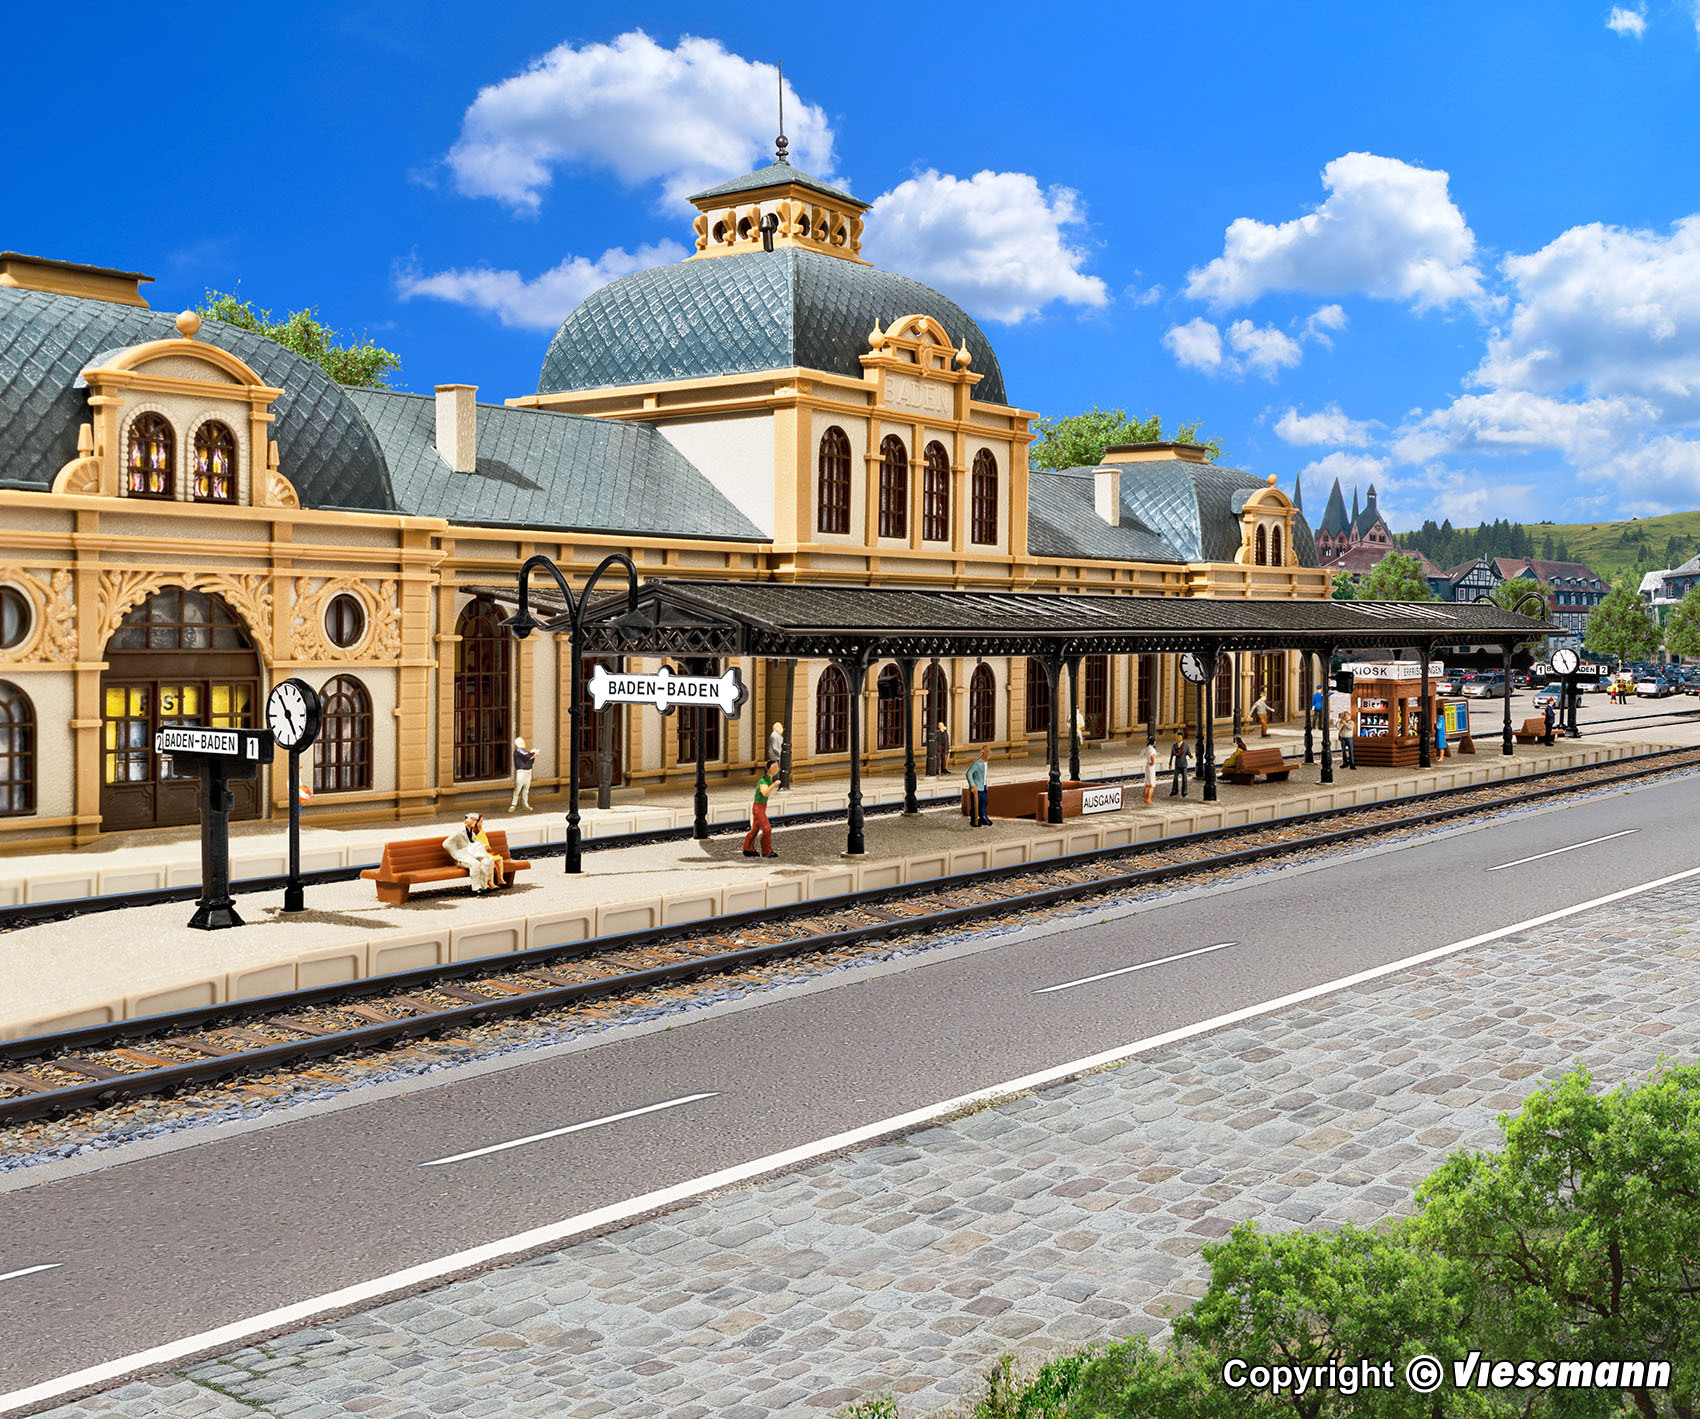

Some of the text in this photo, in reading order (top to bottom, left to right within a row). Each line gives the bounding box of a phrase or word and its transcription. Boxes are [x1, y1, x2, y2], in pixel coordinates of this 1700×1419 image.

[884, 377, 951, 414] BADEN
[1352, 666, 1388, 676] KIOSK
[608, 680, 719, 698] BADEN-BADEN
[165, 732, 235, 752] BADEN-BADEN
[249, 739, 254, 757] 1
[1083, 792, 1120, 808] AUSGANG
